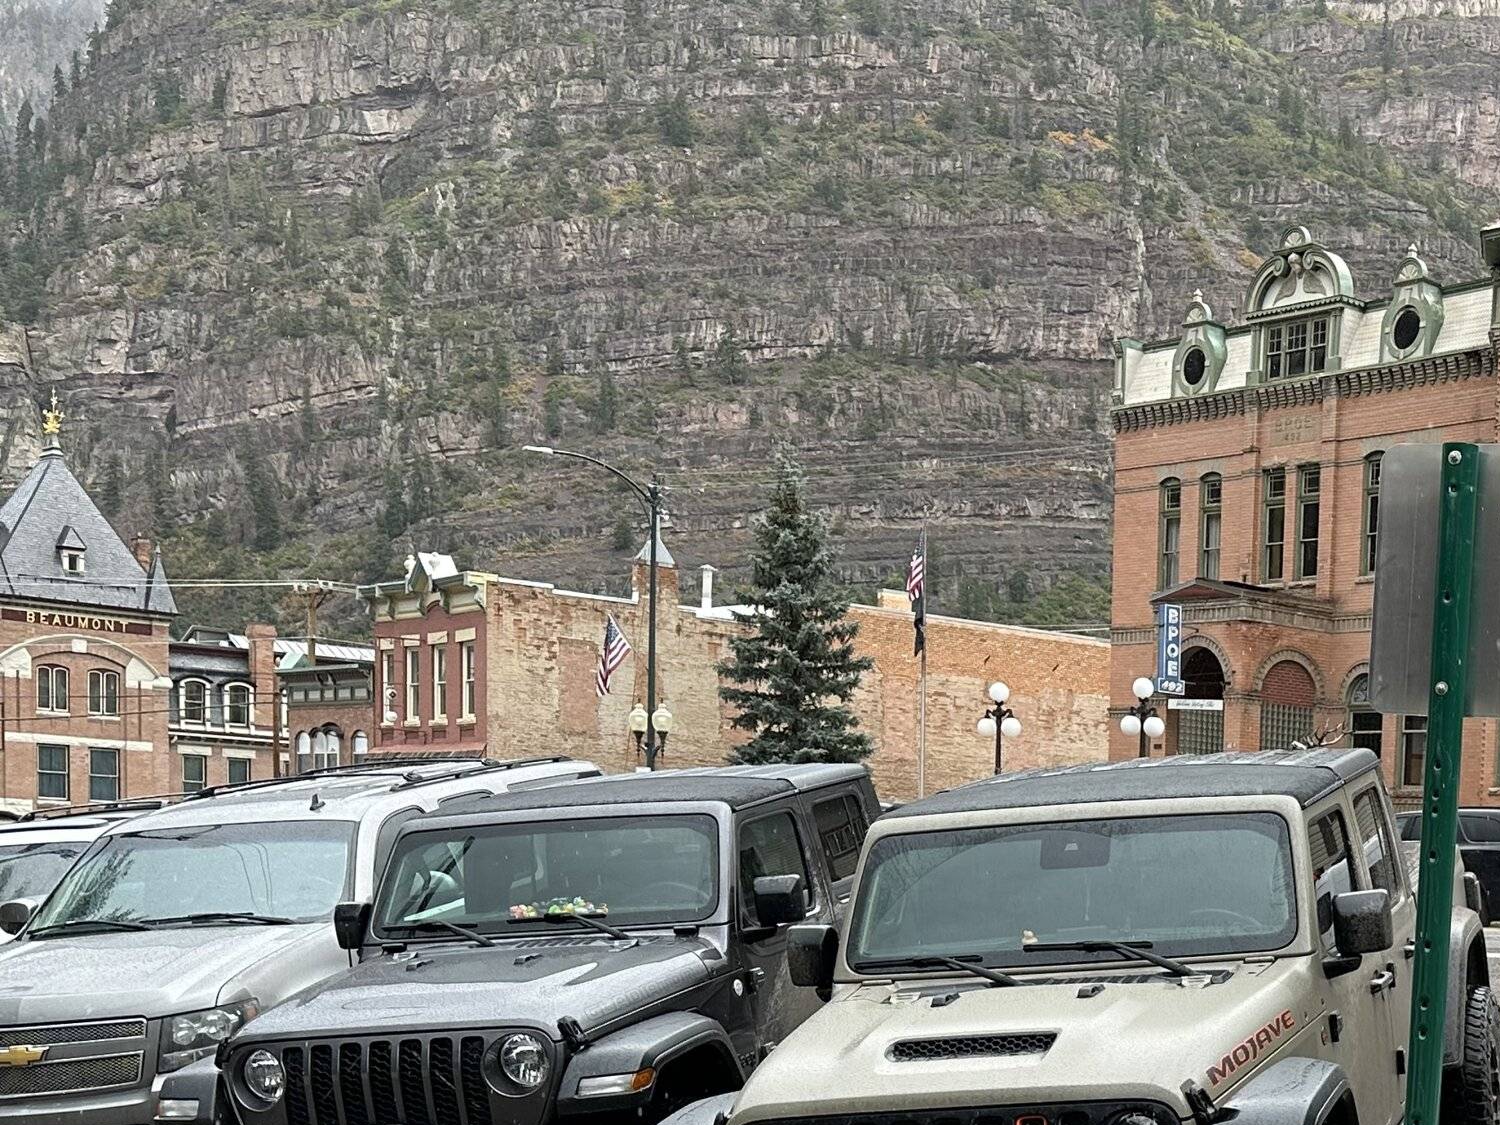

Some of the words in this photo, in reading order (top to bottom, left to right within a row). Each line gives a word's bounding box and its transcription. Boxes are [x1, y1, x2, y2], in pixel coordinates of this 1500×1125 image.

[26, 611, 129, 633] BEAUMONT
[1167, 608, 1179, 677] BPOE
[1161, 680, 1183, 693] 492
[1205, 1008, 1296, 1087] MOJAVE
